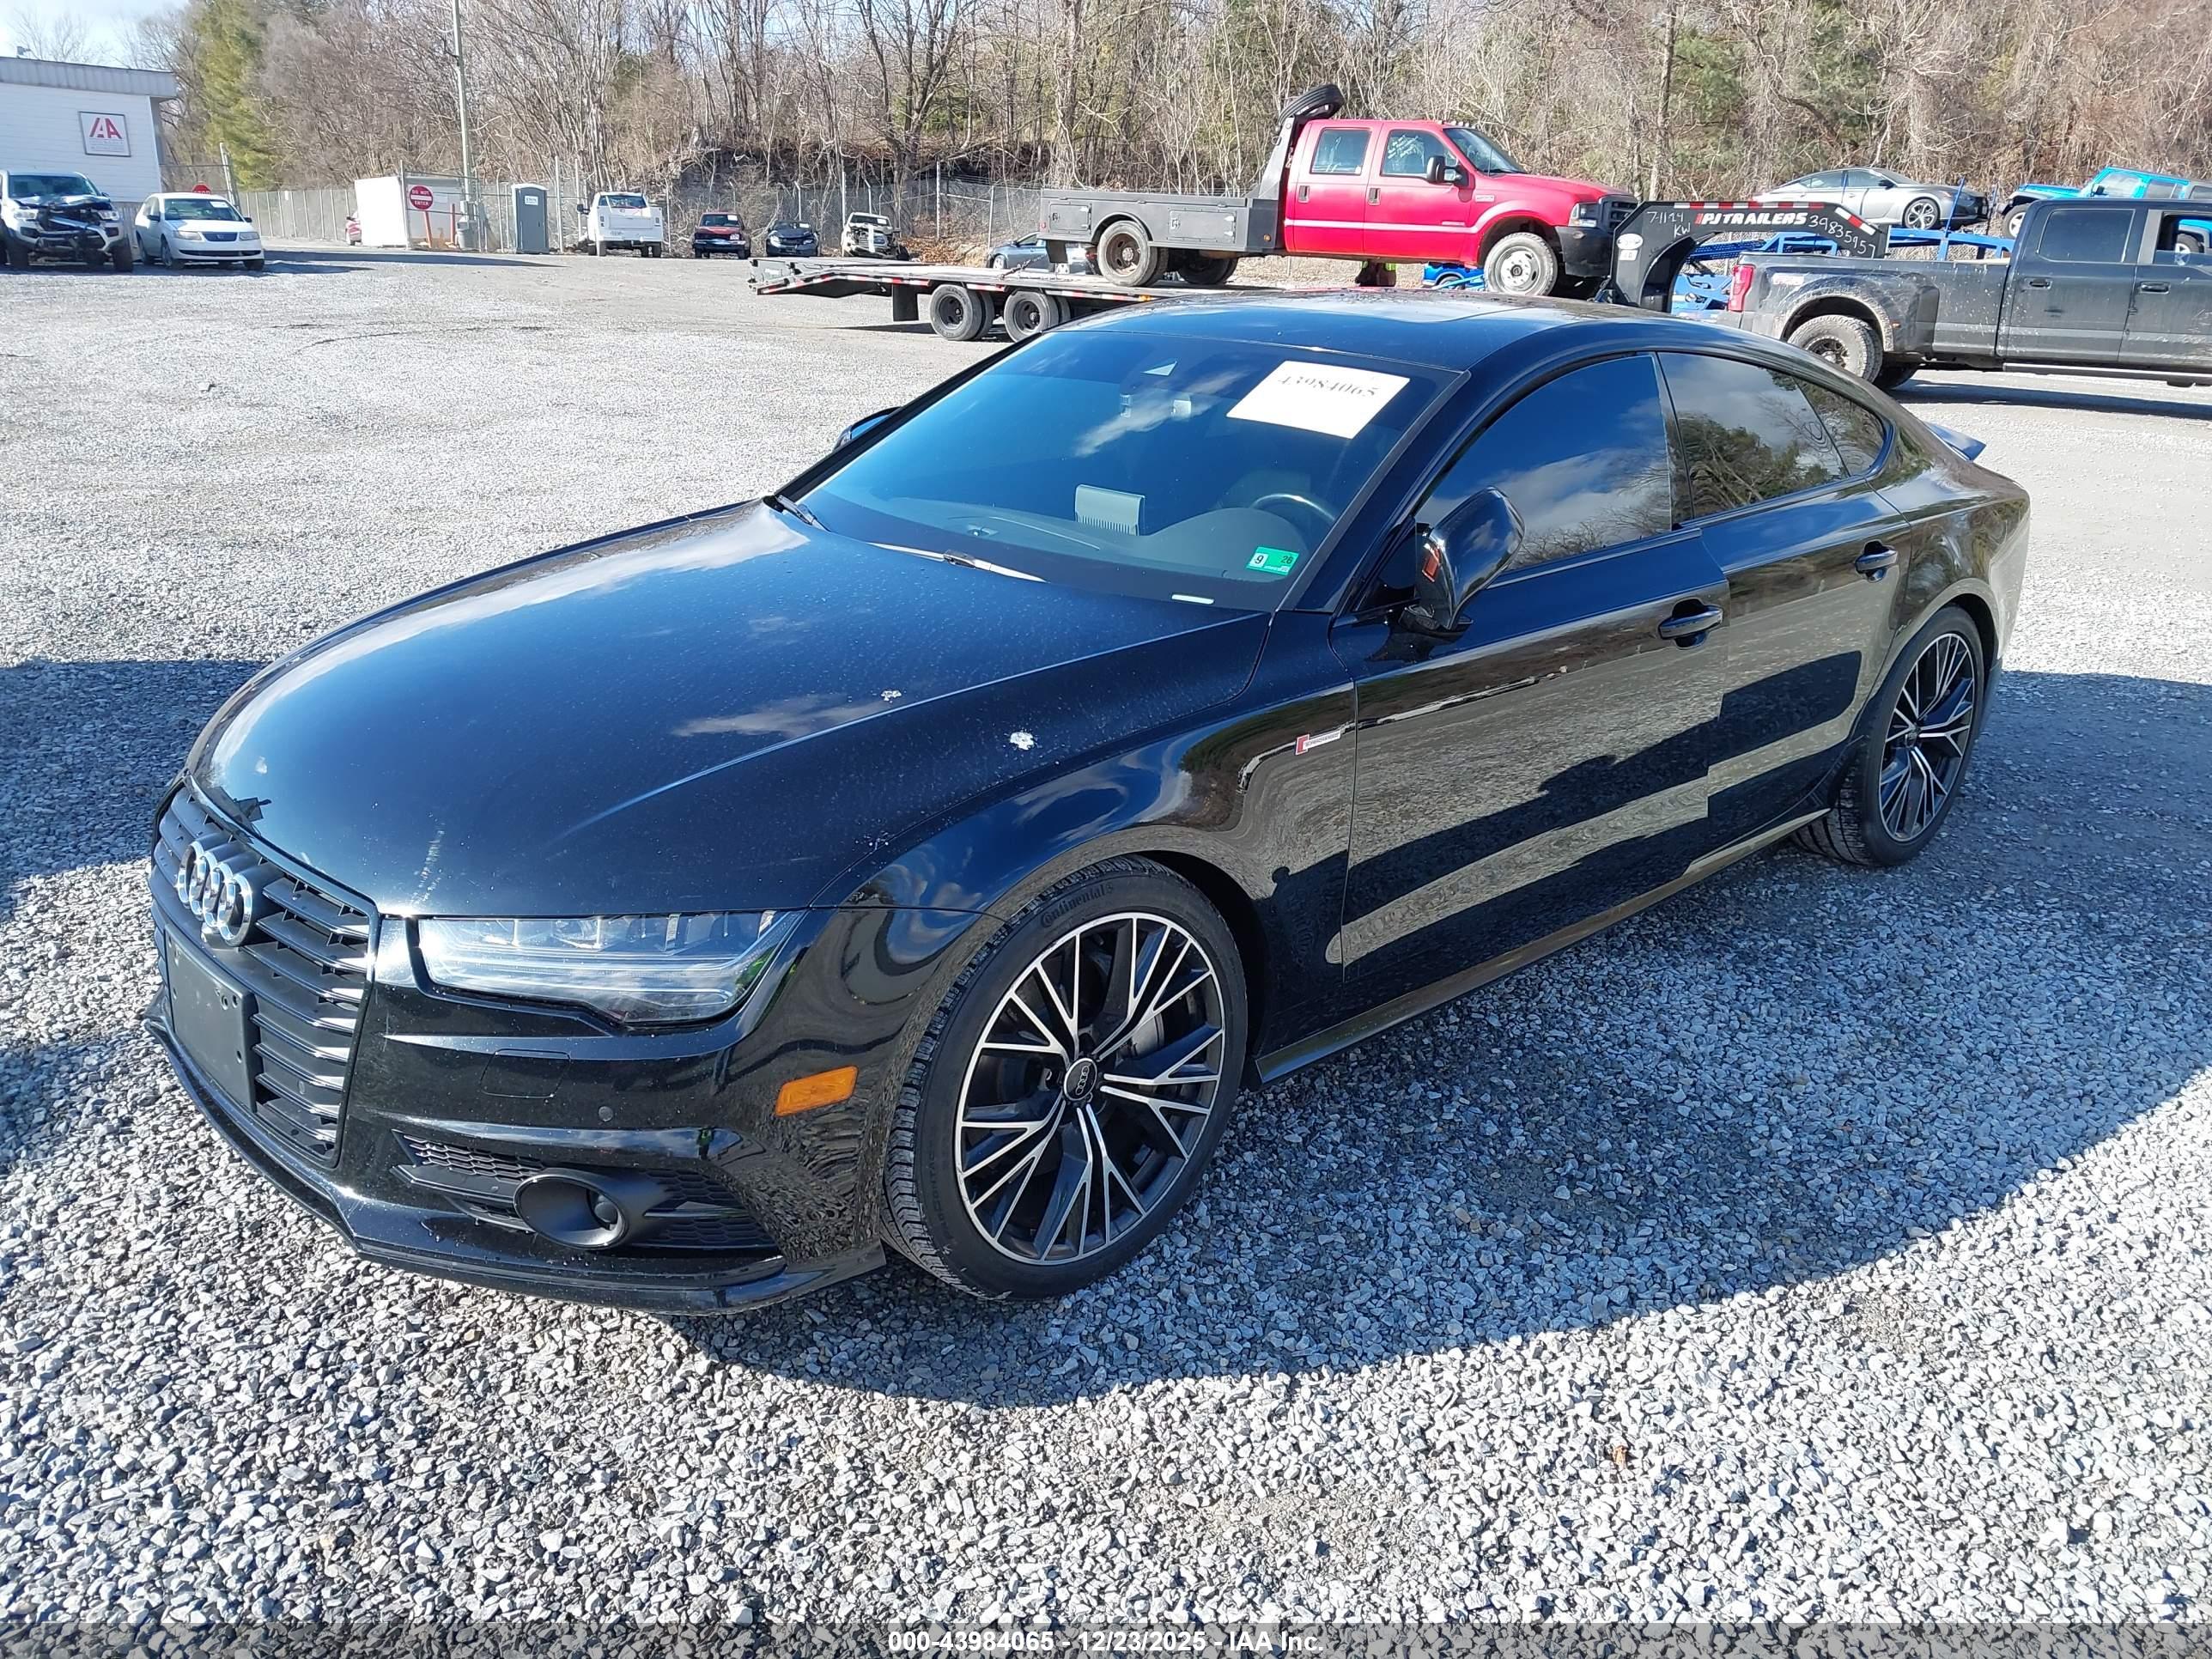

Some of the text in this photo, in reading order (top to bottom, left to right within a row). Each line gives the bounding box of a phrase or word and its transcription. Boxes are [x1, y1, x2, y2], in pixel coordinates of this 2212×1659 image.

[1701, 212, 1808, 225] PJ TRAILERS
[1255, 555, 1294, 564] 9 26
